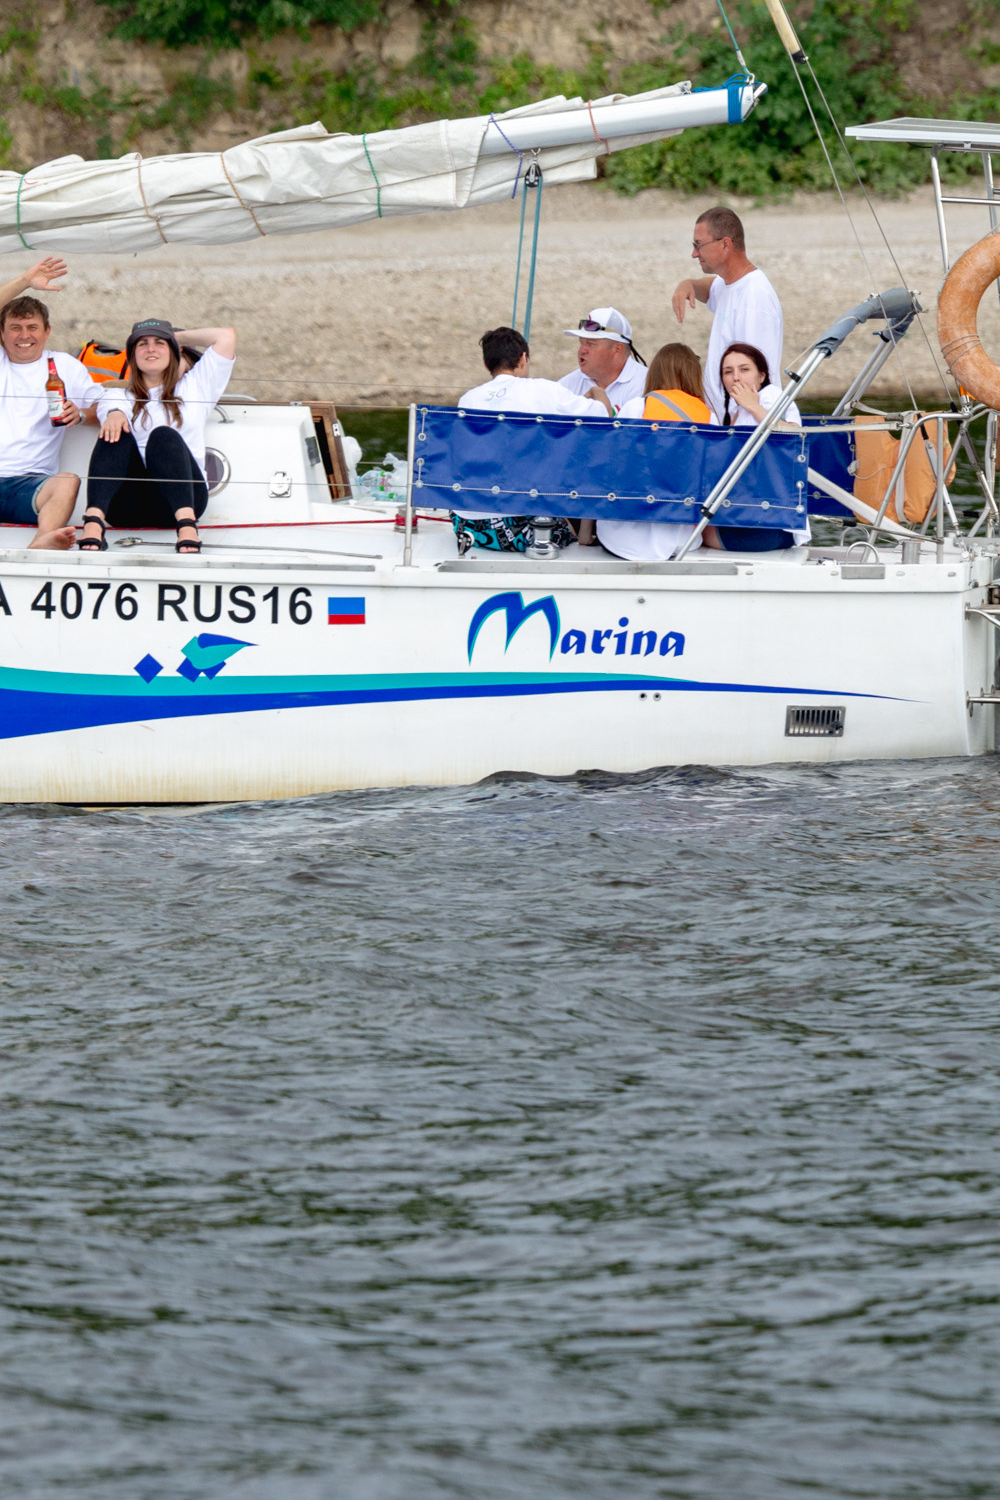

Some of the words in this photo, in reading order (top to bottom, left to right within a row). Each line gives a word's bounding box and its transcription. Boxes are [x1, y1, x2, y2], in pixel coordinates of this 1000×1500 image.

[31, 581, 139, 621] 4076
[157, 583, 313, 625] RUS16
[467, 590, 686, 666] Marina
